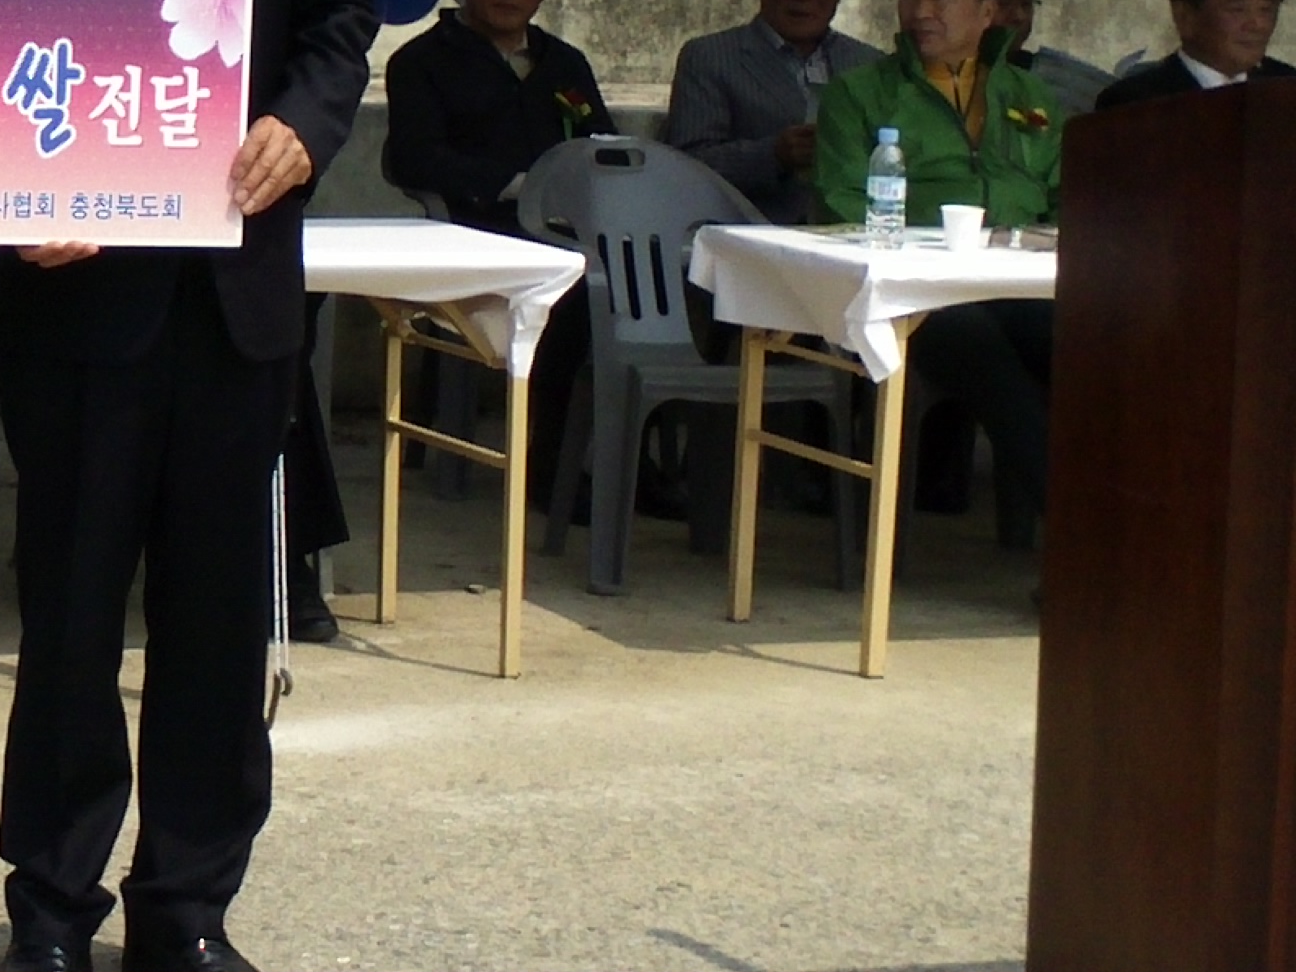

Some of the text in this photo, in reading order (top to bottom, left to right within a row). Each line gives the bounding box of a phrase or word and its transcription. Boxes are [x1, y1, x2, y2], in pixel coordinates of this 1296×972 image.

[5, 40, 84, 156] 쌀
[88, 64, 211, 149] 전달
[70, 192, 182, 221] 충청북도회
